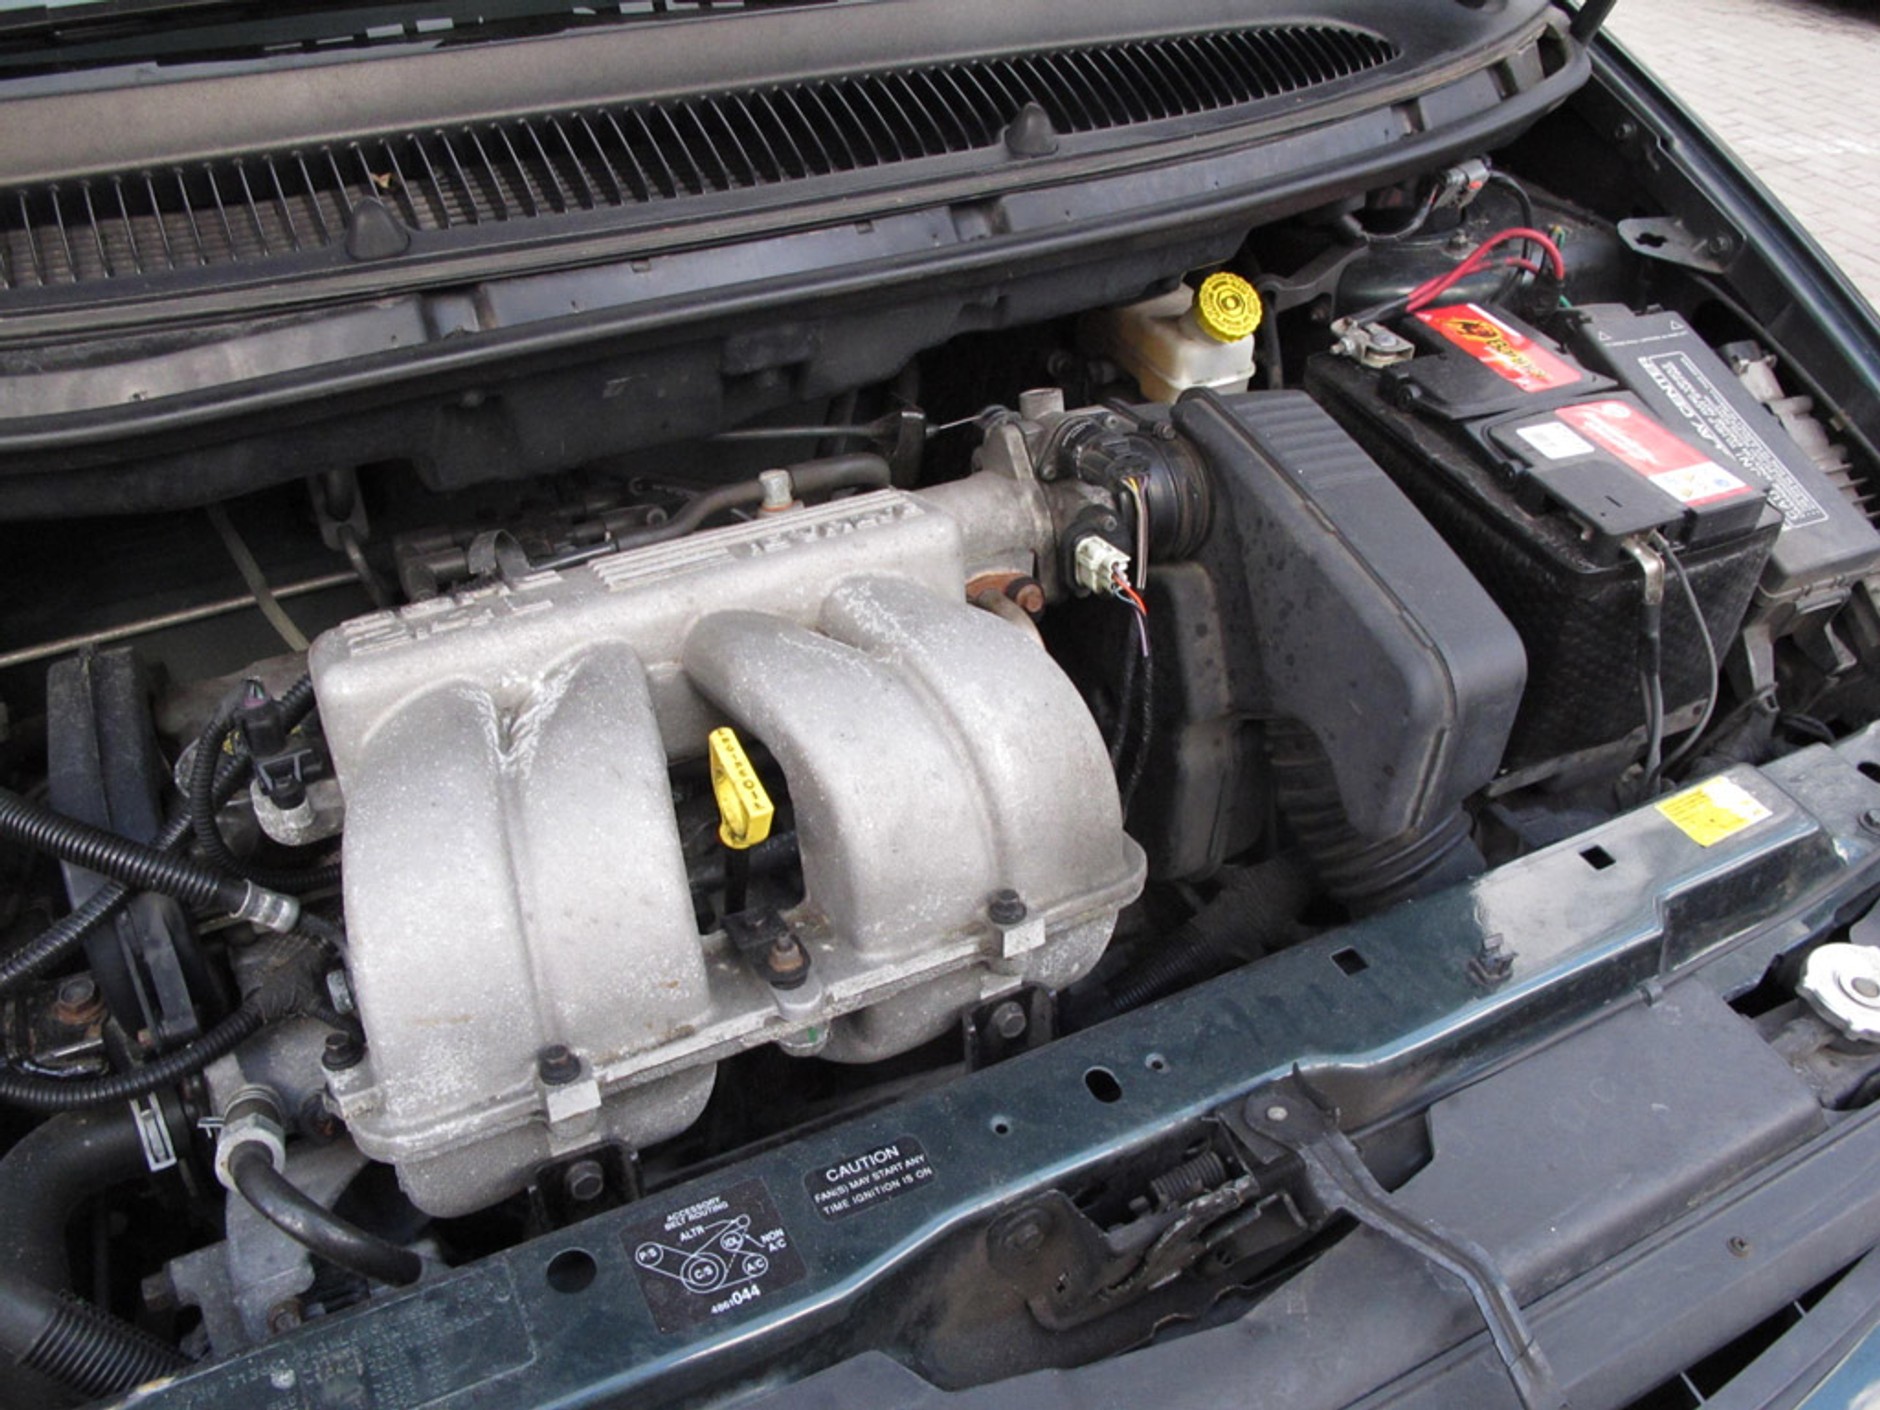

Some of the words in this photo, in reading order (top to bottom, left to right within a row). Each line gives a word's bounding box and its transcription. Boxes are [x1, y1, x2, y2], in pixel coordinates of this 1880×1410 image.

[1636, 357, 1695, 418] CENTER
[814, 1184, 849, 1203] FAN(S)
[848, 1174, 870, 1190] MAY
[872, 1161, 904, 1181] START
[905, 1154, 925, 1169] ANY
[826, 1145, 900, 1182] CAUTION
[823, 1199, 850, 1215] TIME
[852, 1179, 901, 1204] IGNITION
[902, 1174, 914, 1184] IS
[915, 1166, 933, 1179] ON
[760, 1228, 785, 1243] NON
